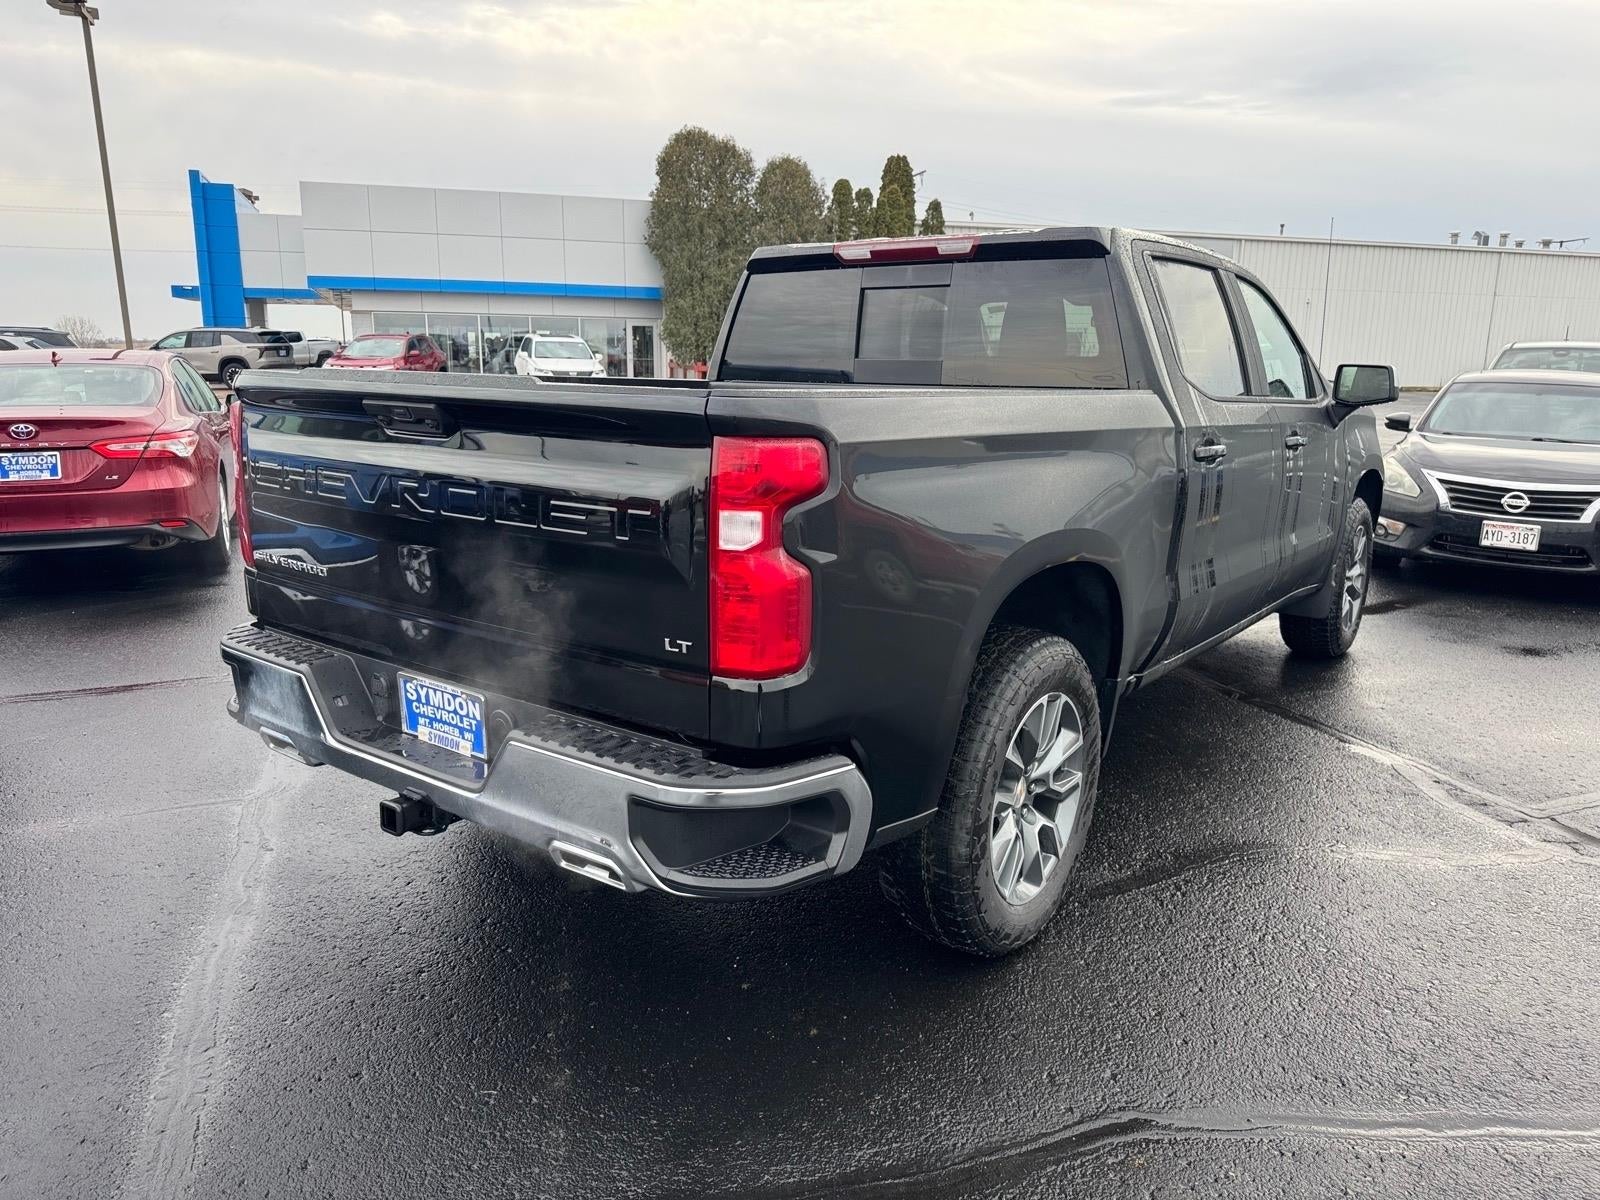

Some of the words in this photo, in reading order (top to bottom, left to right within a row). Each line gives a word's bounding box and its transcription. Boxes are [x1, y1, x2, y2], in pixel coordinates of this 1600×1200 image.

[1, 455, 56, 465] SYMDON
[4, 463, 53, 471] CHEVROLET
[249, 458, 655, 541] CHEVROLET
[1483, 529, 1537, 545] AYD-3187
[255, 551, 328, 577] SILVERADO
[664, 638, 693, 654] LT
[406, 682, 481, 721] SYMDON
[412, 701, 477, 731] CHEVROLET
[418, 716, 432, 728] MT.
[464, 731, 475, 742] WI
[427, 731, 460, 751] SYMDON
